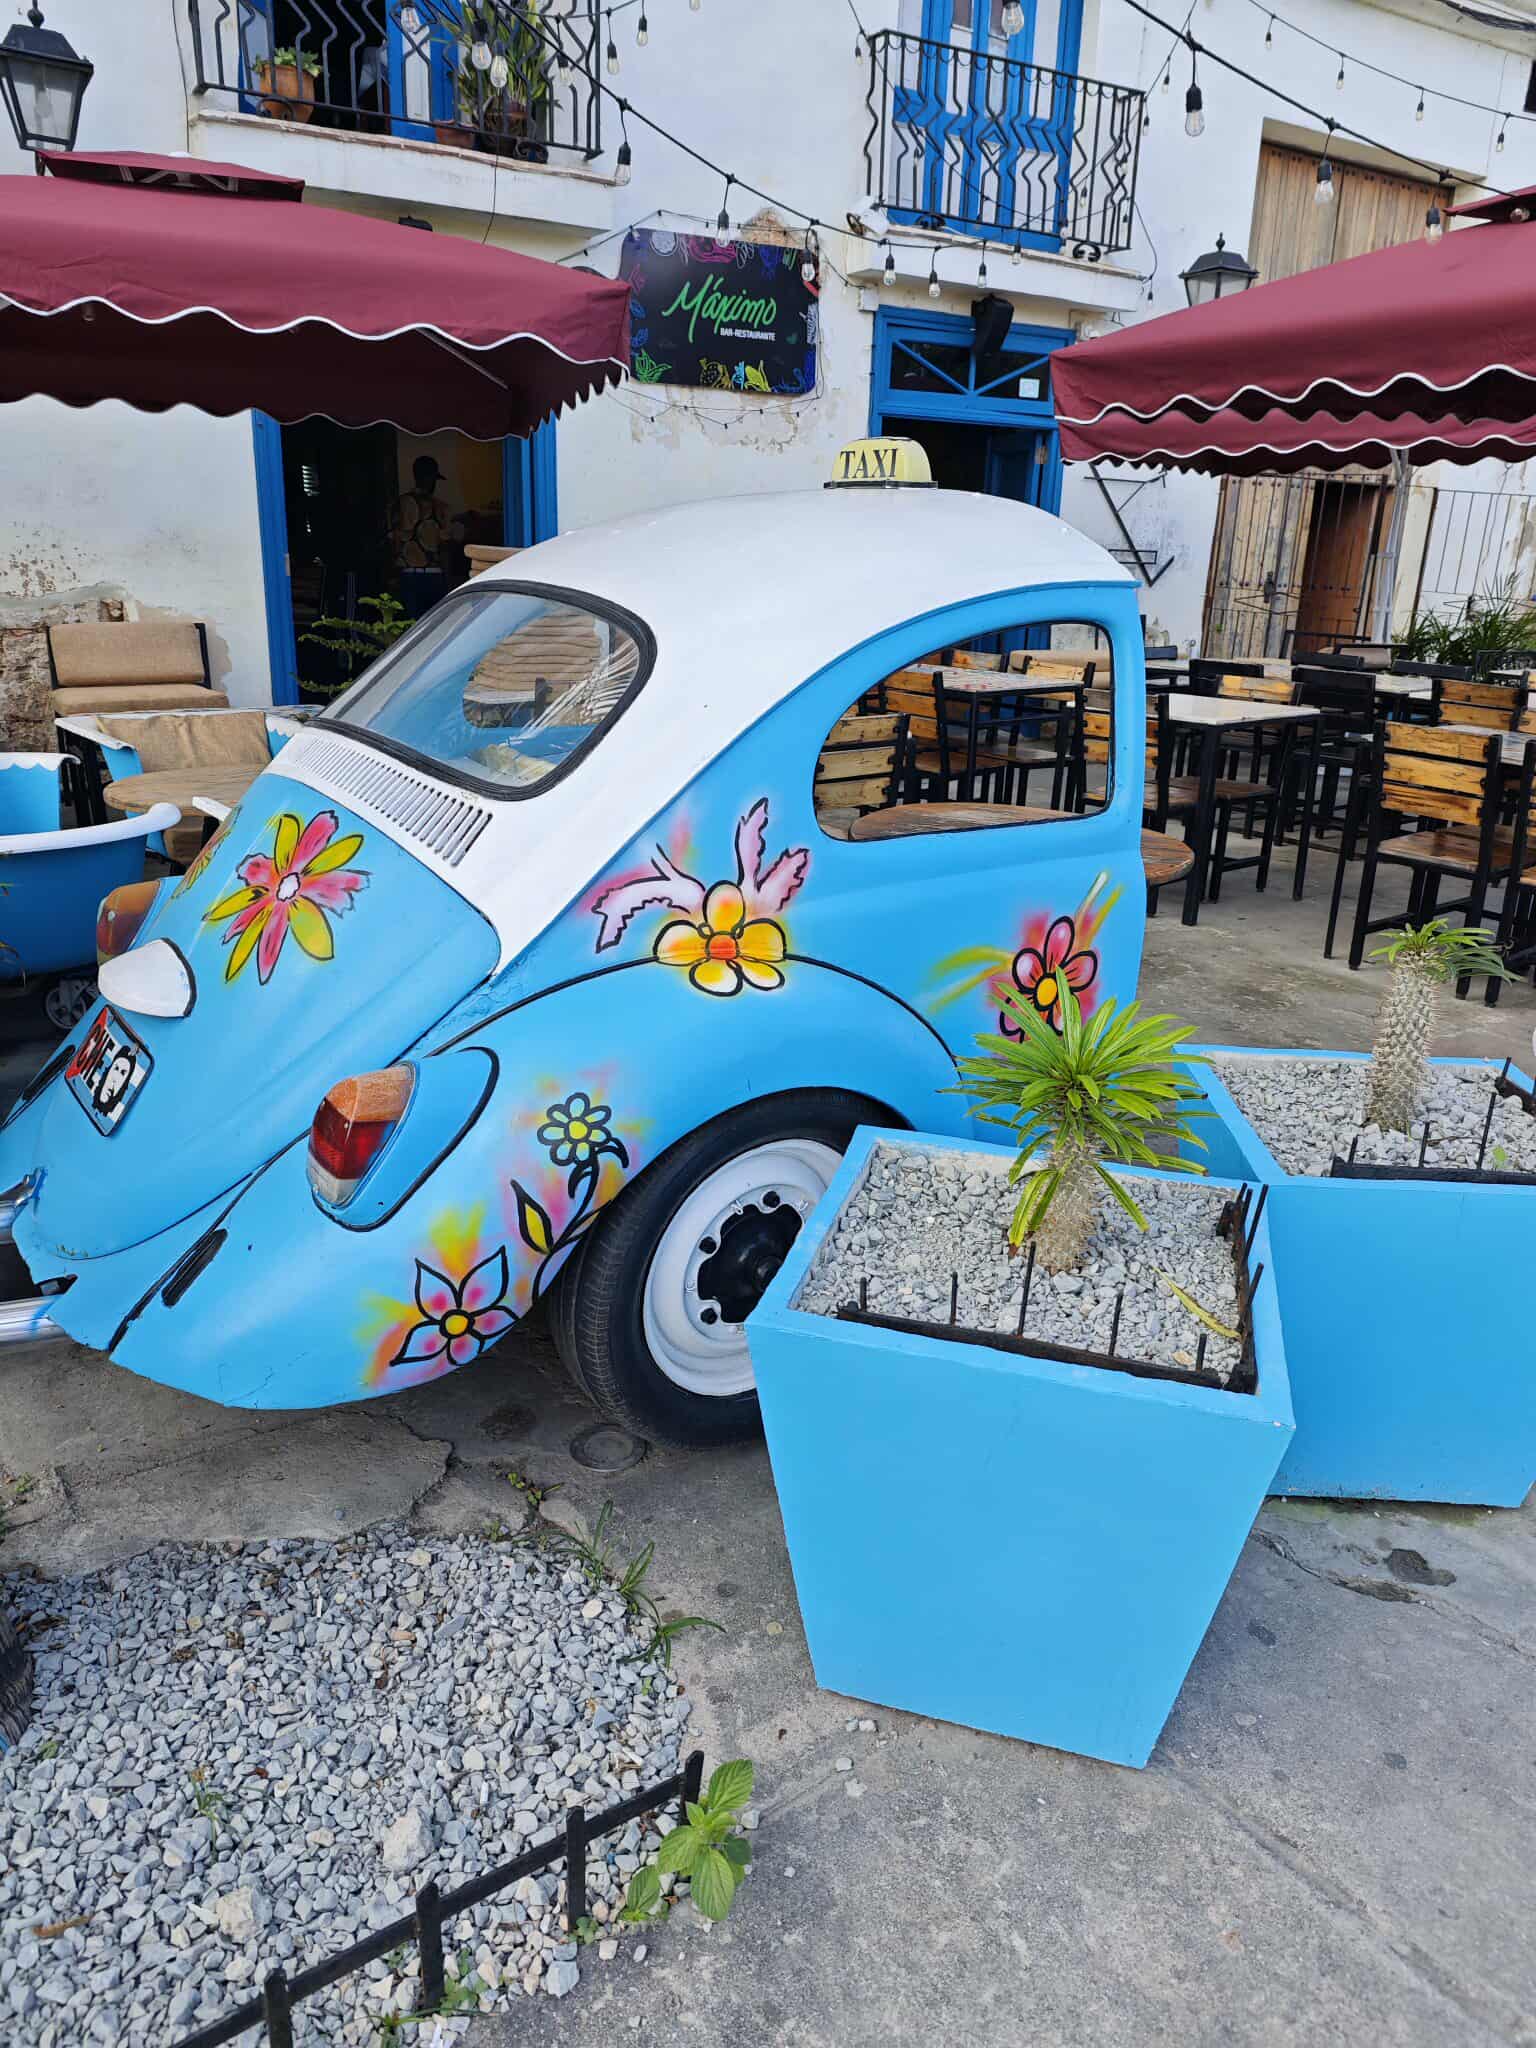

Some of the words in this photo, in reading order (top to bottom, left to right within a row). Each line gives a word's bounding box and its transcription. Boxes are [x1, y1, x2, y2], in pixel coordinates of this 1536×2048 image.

[661, 273, 777, 344] Máximo
[719, 327, 776, 341] BAR-RESTAURANTE
[840, 448, 898, 479] TAXI
